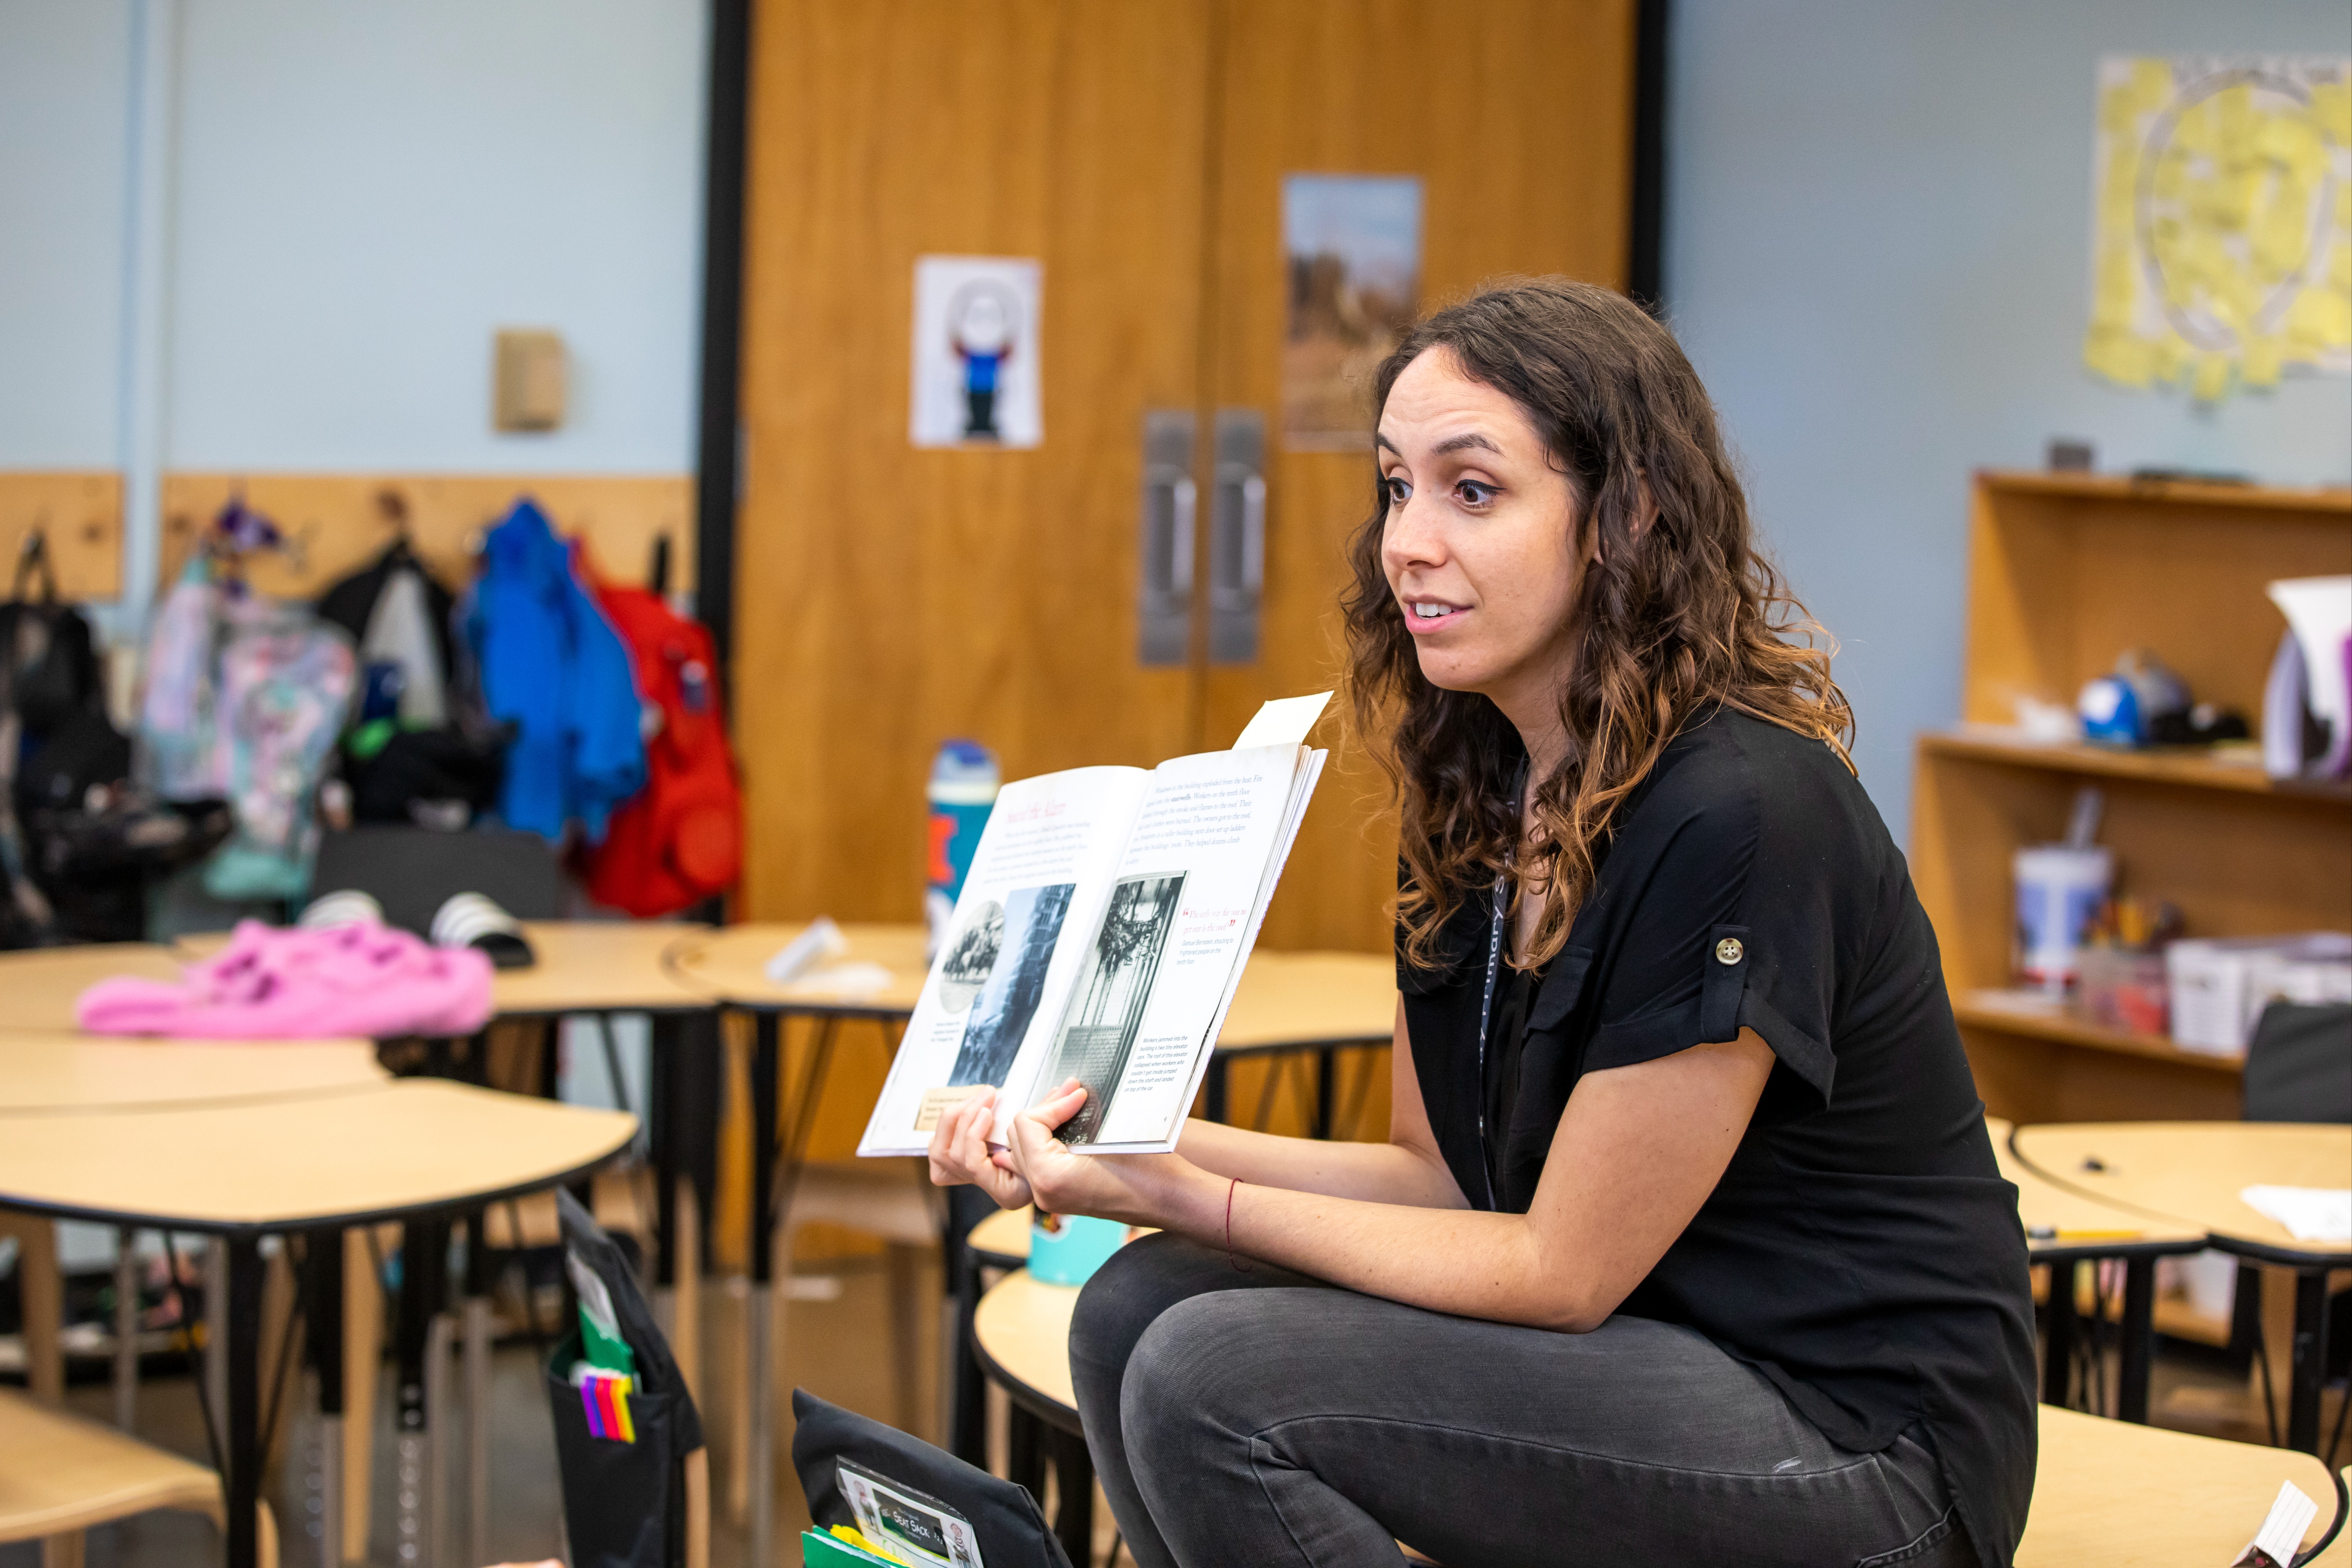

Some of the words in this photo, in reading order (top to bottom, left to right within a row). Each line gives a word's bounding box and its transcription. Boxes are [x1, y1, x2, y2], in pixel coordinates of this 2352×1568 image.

[1202, 779, 1222, 788] exploded
[1241, 811, 1252, 819] roof,
[1176, 828, 1194, 837] building
[1184, 839, 1195, 848] They
[1196, 838, 1211, 848] helped
[1182, 927, 1192, 936] get
